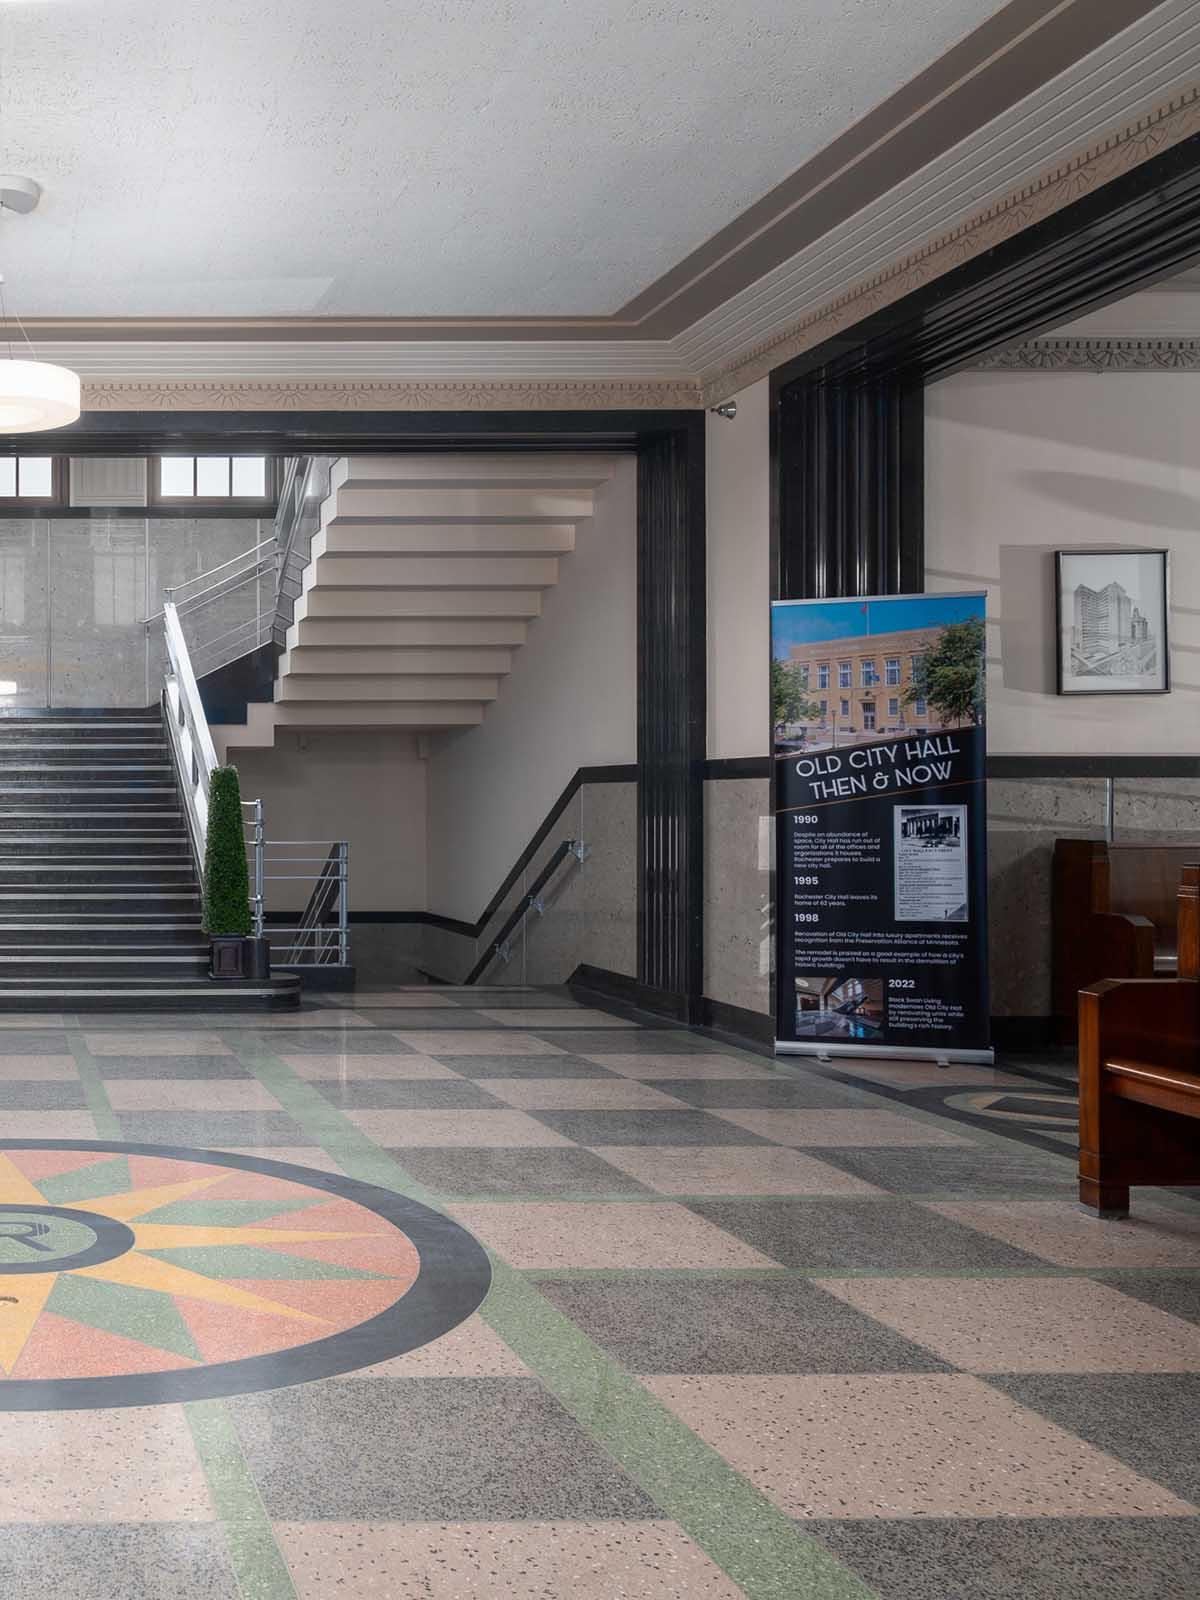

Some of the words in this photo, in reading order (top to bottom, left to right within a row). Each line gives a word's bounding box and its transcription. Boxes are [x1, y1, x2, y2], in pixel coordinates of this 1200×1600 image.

[796, 756, 841, 776] OLD
[849, 745, 897, 768] CITY
[904, 736, 960, 760] HALL
[809, 775, 867, 799] THEN
[873, 772, 888, 789] &
[895, 761, 952, 786] NOW
[794, 816, 818, 824] 1990
[794, 877, 818, 885] 1995
[795, 914, 819, 922] 1998
[888, 979, 915, 988] 2022
